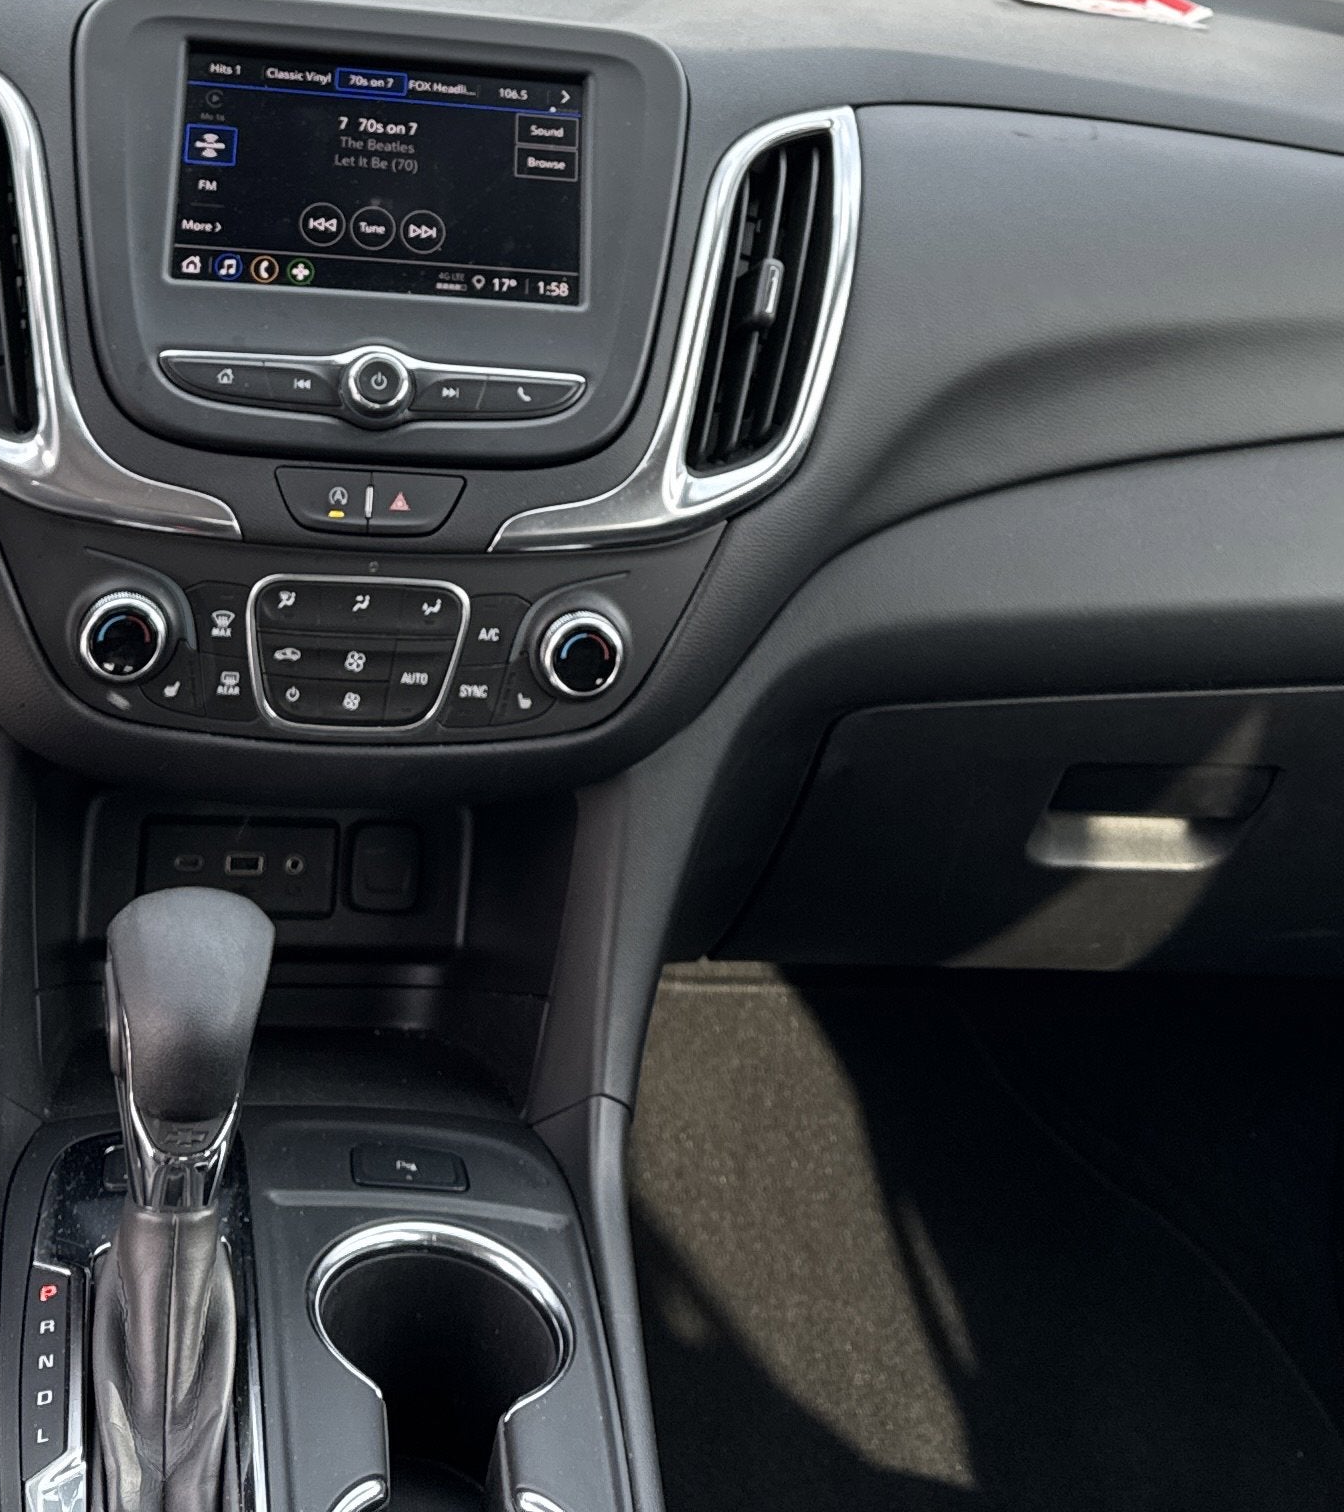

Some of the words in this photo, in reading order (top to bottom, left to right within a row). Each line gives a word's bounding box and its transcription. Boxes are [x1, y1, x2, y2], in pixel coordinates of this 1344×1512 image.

[210, 63, 232, 76] Hits
[235, 64, 241, 76] 1
[266, 67, 302, 82] Classic
[304, 70, 332, 85] Vinyl
[349, 75, 368, 87] 70s
[370, 78, 383, 88] on
[385, 77, 394, 89] 7
[408, 79, 431, 93] FOX
[498, 88, 528, 102] 106.5
[337, 117, 348, 131] 7
[358, 118, 385, 133] 70s
[387, 121, 406, 135] on
[408, 121, 418, 135] 7
[530, 124, 564, 139] Sound
[339, 136, 363, 151] The
[366, 138, 415, 155] Beatles
[334, 154, 355, 168] Let
[358, 155, 368, 169] It
[371, 156, 388, 170] Be
[391, 157, 419, 174] (70)
[527, 156, 566, 171] Browse
[198, 179, 217, 192] FM
[181, 219, 212, 231] More
[359, 220, 386, 234] Tune
[492, 278, 518, 292] 17°
[537, 281, 569, 297] 1:58
[211, 626, 232, 637] MAX
[478, 626, 500, 643] A/C
[400, 672, 428, 685] AUTO
[217, 684, 240, 696] REAR
[459, 684, 488, 698] SYNC
[39, 1284, 57, 1302] P
[39, 1319, 55, 1334] R
[38, 1354, 54, 1369] N
[37, 1390, 53, 1406] D
[36, 1428, 49, 1443] L
